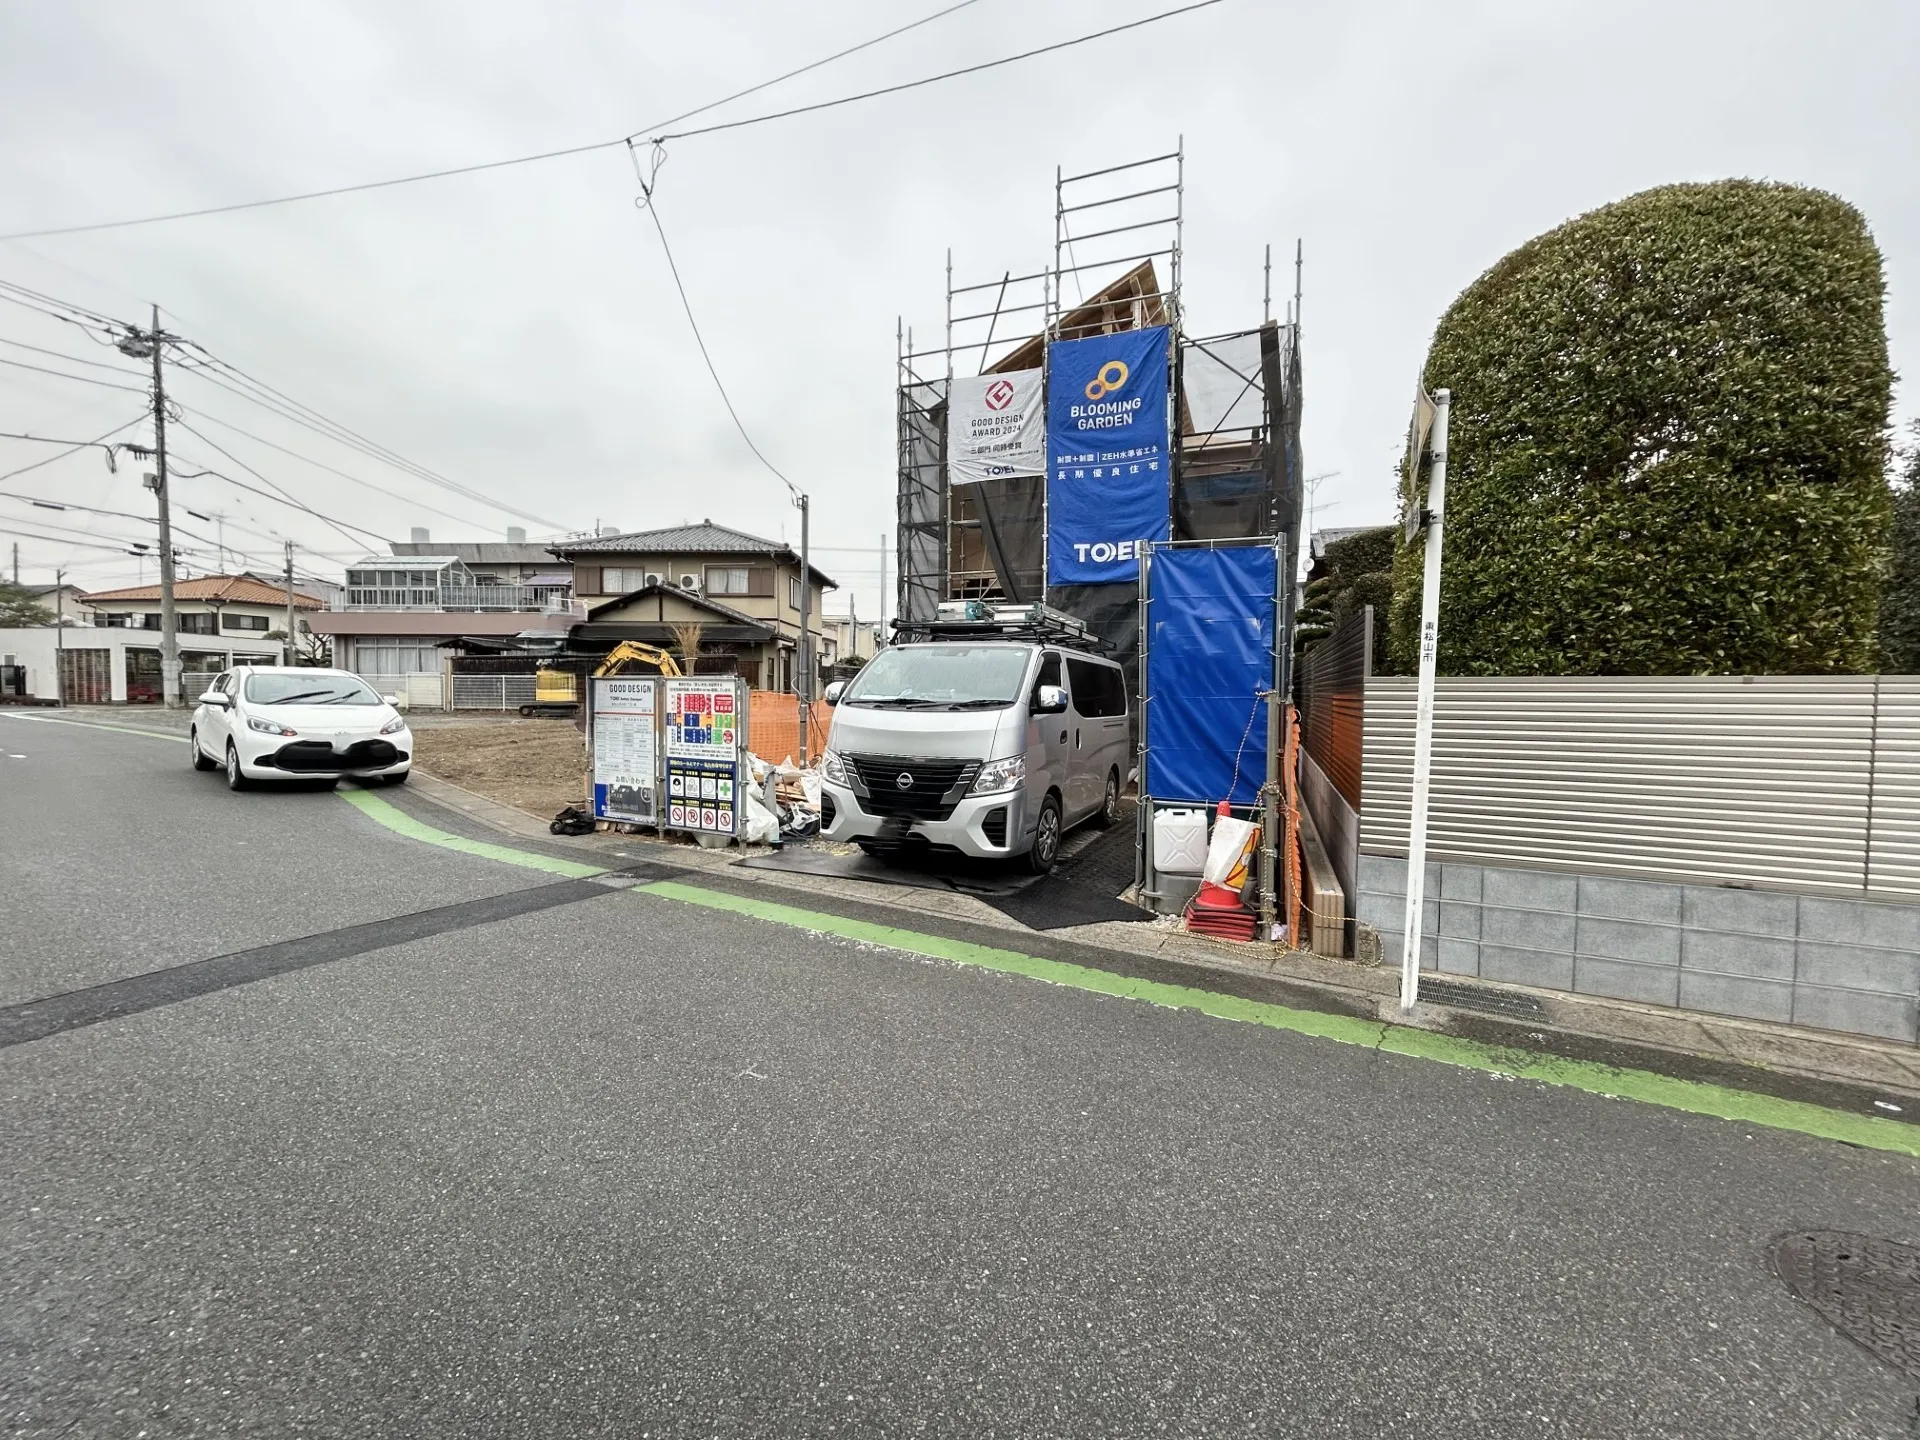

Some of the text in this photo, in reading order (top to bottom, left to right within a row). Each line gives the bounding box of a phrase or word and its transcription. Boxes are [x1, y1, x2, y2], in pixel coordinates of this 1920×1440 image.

[1070, 397, 1141, 418] BLOOMING
[971, 414, 1025, 428] GOOD DESIGN
[1077, 412, 1133, 430] GARDEN
[971, 424, 1022, 438] AWARD 2024
[1422, 621, 1434, 663] 東松山市
[609, 684, 652, 694] GOOD DESIGN
